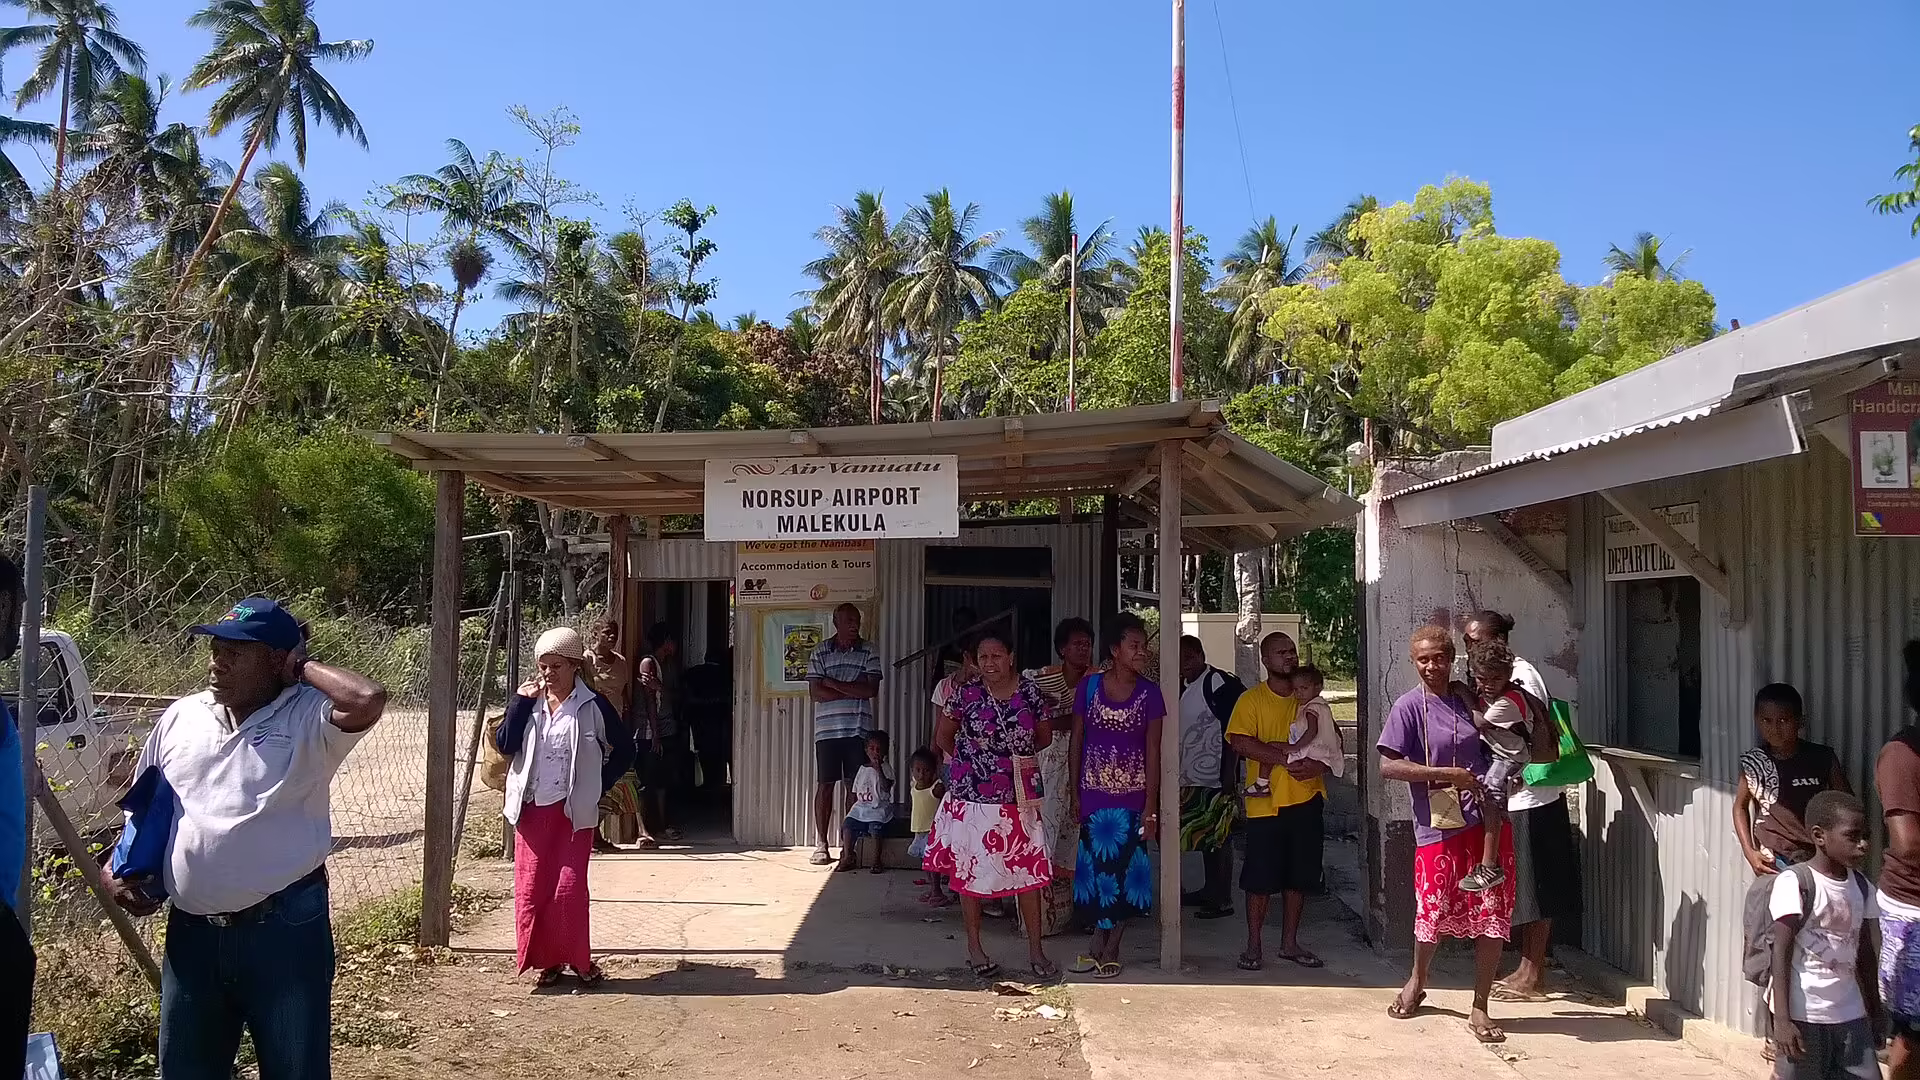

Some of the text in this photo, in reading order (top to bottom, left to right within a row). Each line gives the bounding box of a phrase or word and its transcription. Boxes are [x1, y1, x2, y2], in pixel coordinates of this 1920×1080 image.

[779, 461, 942, 475] Air Vanuatu
[742, 487, 921, 508] NORSUP AIRPORT
[777, 513, 886, 533] MALEKULA
[745, 541, 776, 550] We've
[779, 541, 798, 551] got
[801, 541, 817, 549] the
[740, 559, 871, 571] Accommodation & Tours
